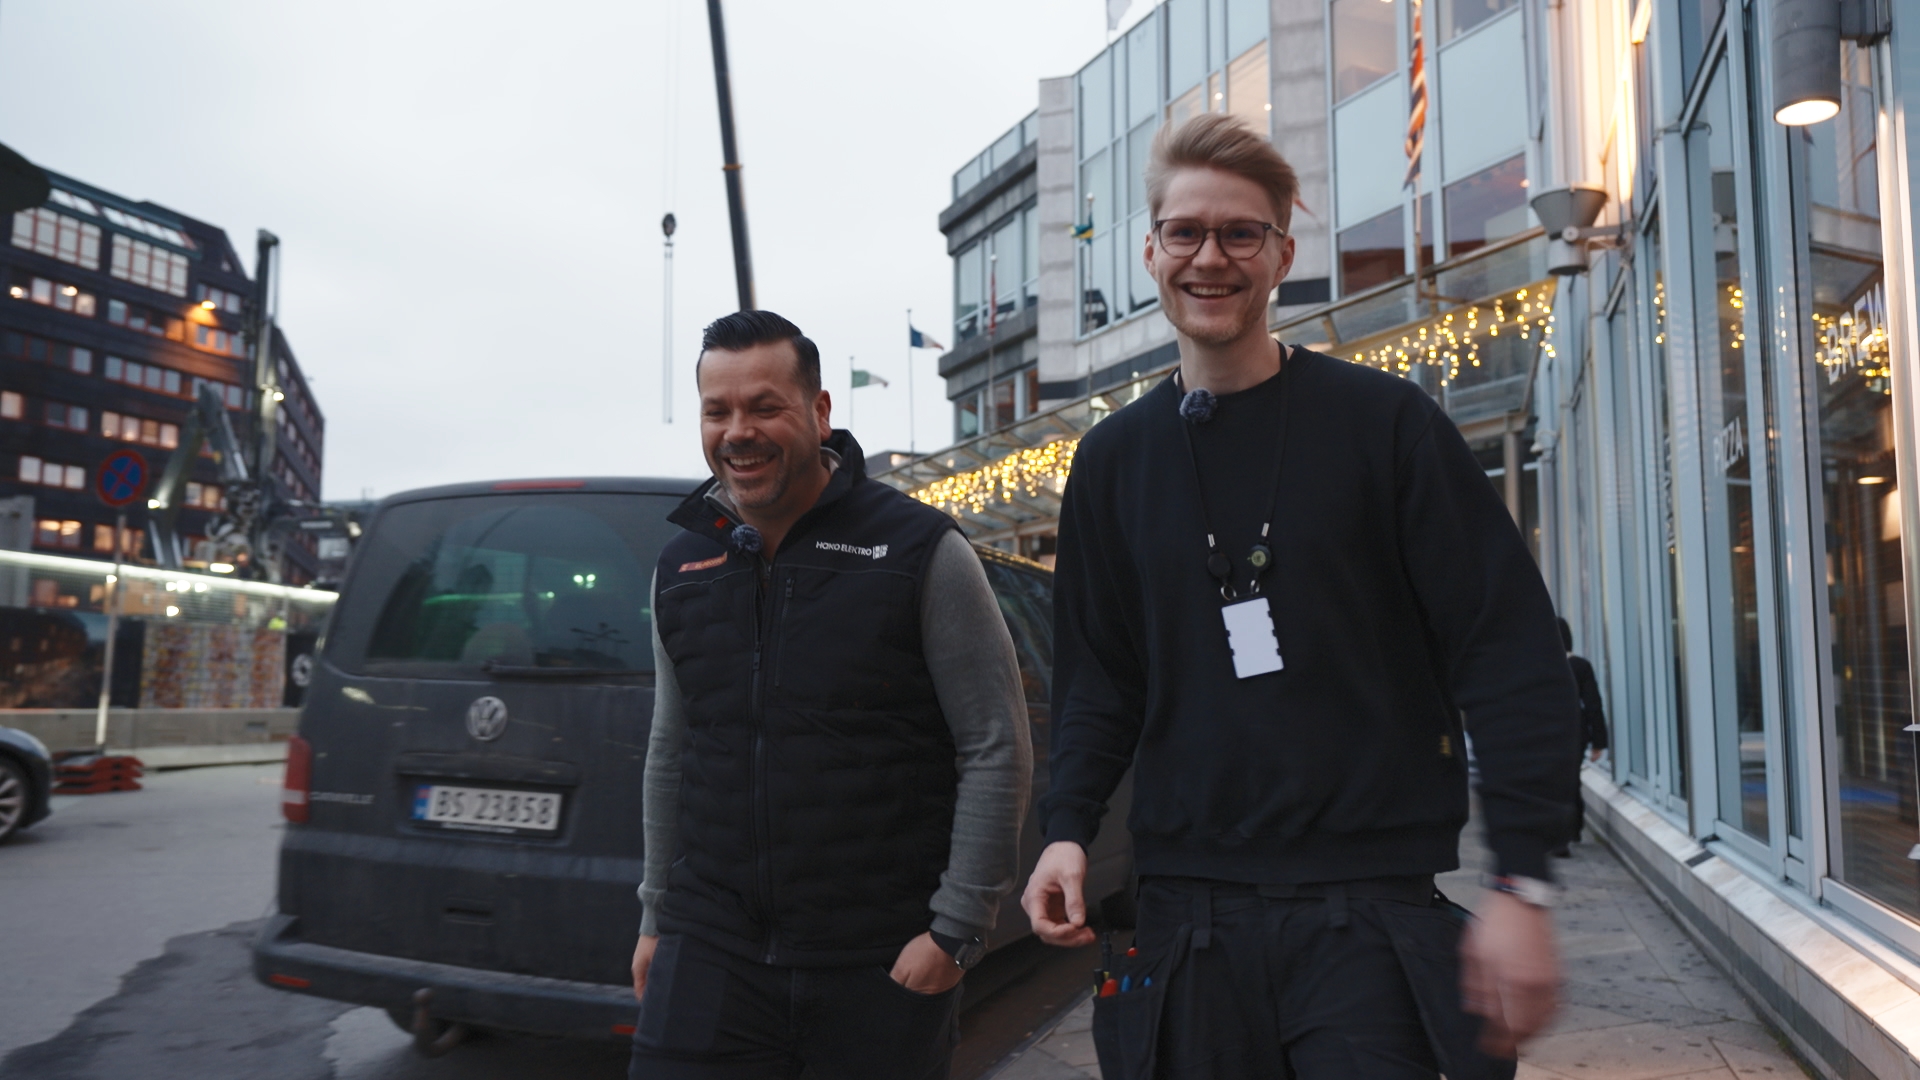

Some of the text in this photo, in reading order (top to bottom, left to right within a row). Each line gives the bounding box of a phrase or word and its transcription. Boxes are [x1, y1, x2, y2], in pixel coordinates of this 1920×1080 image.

[1713, 416, 1744, 477] PIZZA
[435, 790, 464, 818] BS
[473, 793, 555, 825] 23858
